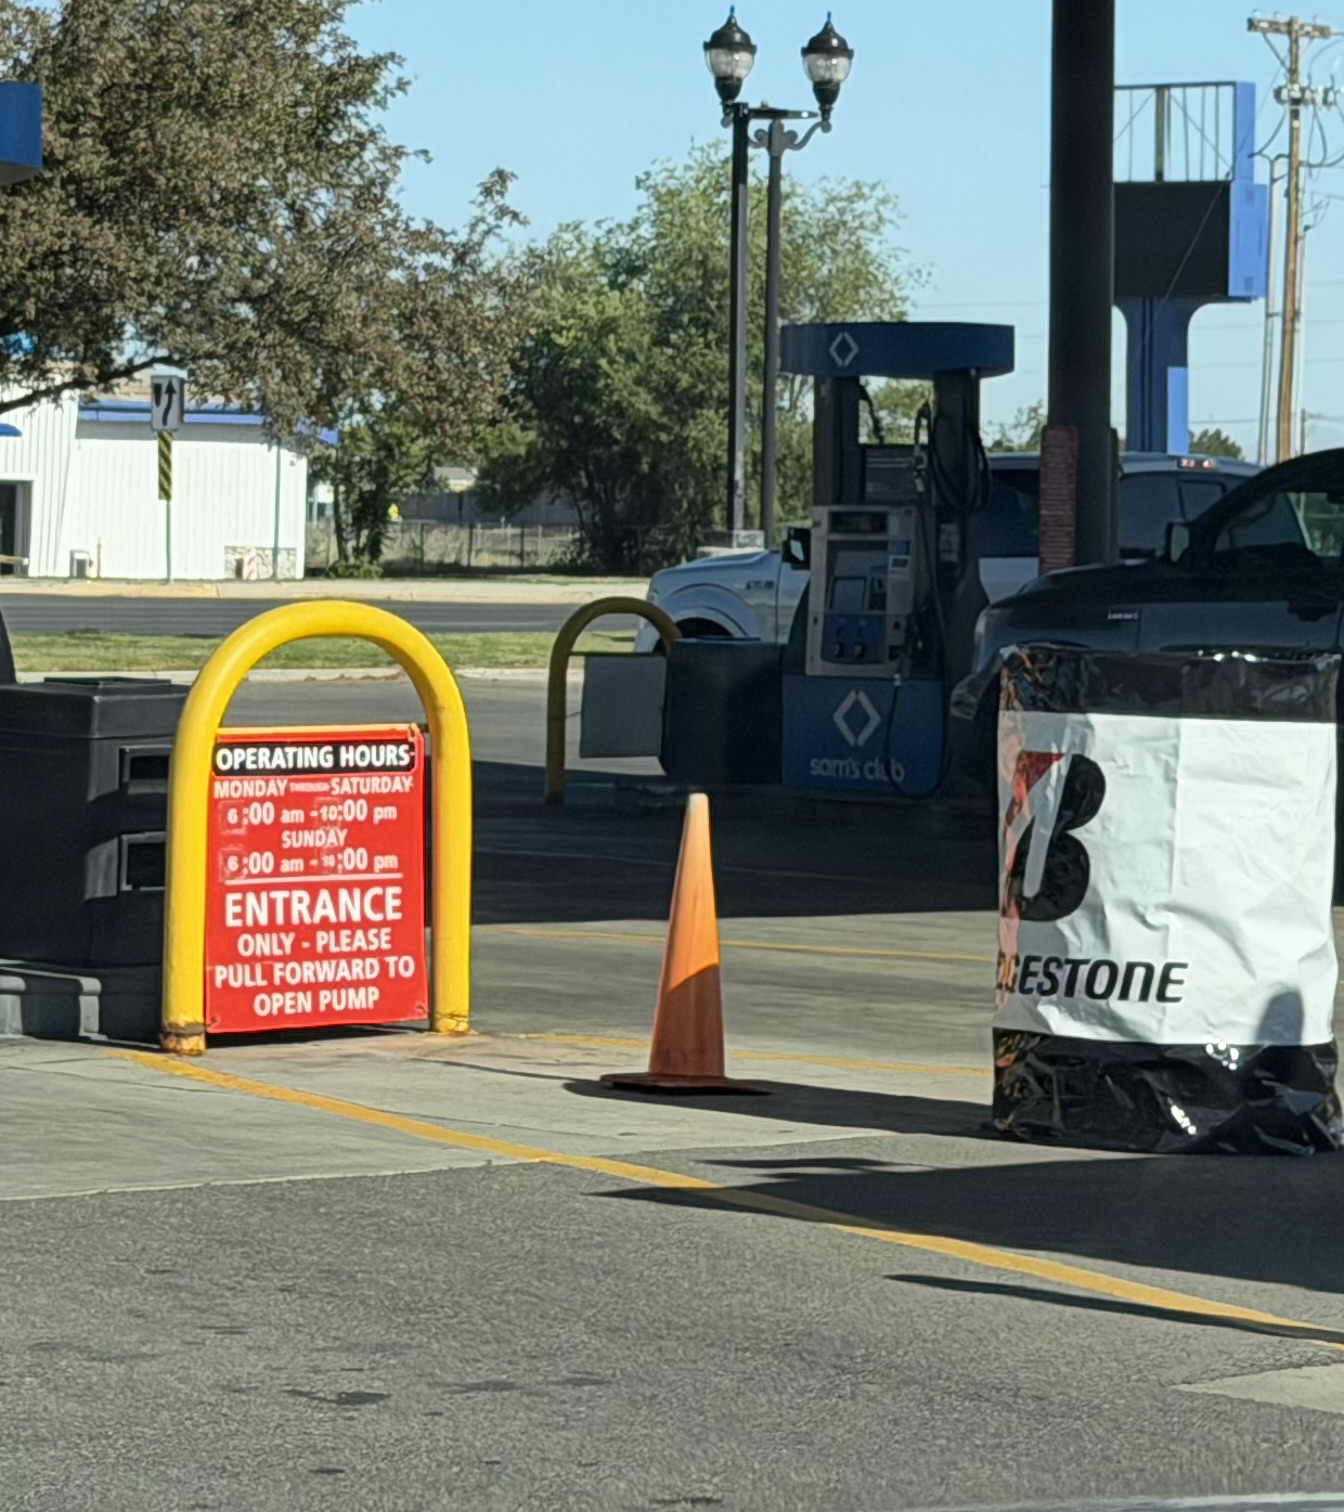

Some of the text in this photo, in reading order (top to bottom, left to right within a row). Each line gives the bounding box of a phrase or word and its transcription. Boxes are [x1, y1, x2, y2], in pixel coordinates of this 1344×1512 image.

[216, 744, 410, 771] OPERATING HOURS
[214, 778, 287, 799] MONDAY
[331, 775, 411, 795] SATURDAY
[281, 808, 305, 824] am
[373, 805, 398, 825] pm
[281, 828, 348, 848] SUNDAY
[280, 857, 304, 873] am
[374, 855, 398, 874] pm
[225, 886, 403, 927] ENTRANCE
[237, 931, 296, 957] ONLY
[316, 927, 392, 954] PLEASE
[215, 955, 415, 989] PULL FORWARD TO
[253, 986, 380, 1017] OPEN PUMP
